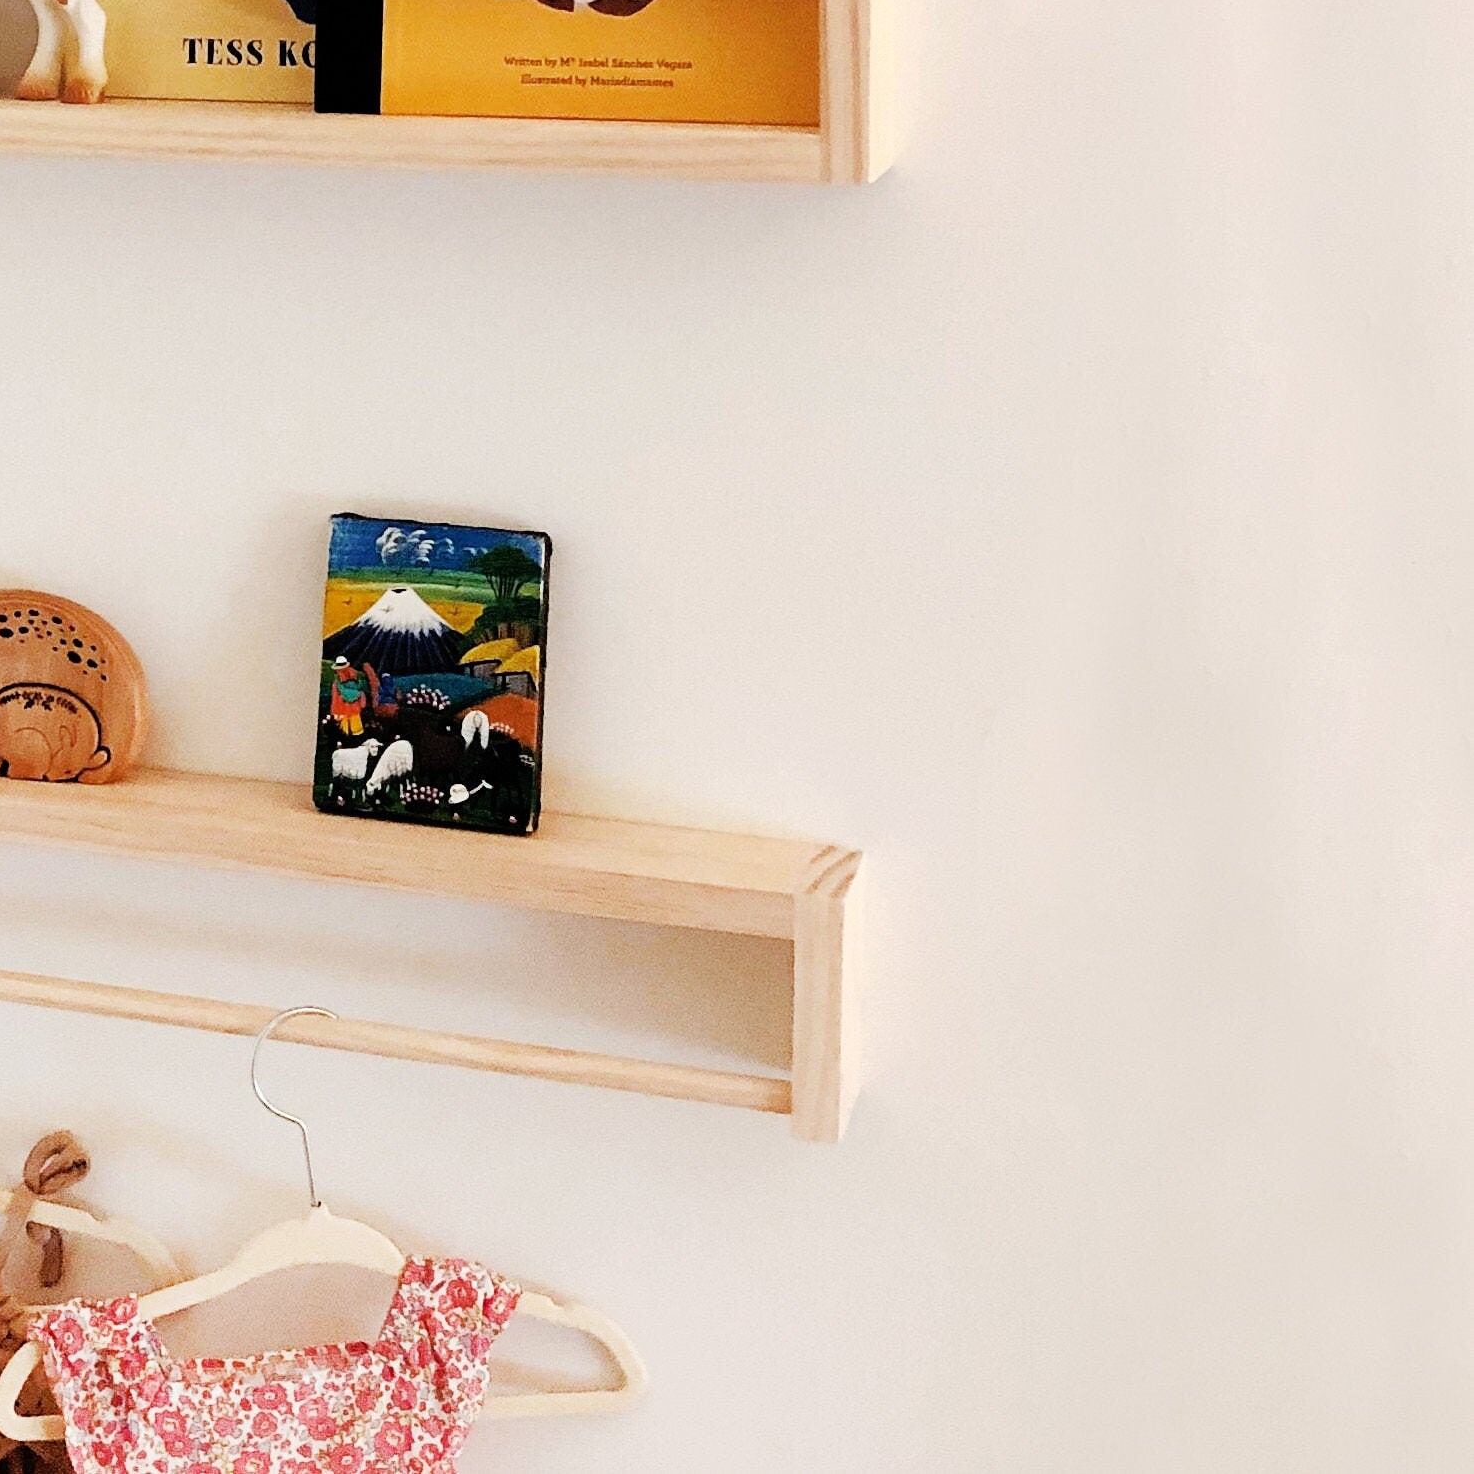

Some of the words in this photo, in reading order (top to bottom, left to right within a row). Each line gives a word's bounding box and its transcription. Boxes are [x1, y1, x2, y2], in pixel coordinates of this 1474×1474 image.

[182, 37, 264, 67] TESS
[504, 56, 543, 67] Written
[544, 56, 557, 68] by
[521, 73, 573, 85] Illustrated
[574, 74, 587, 87] by
